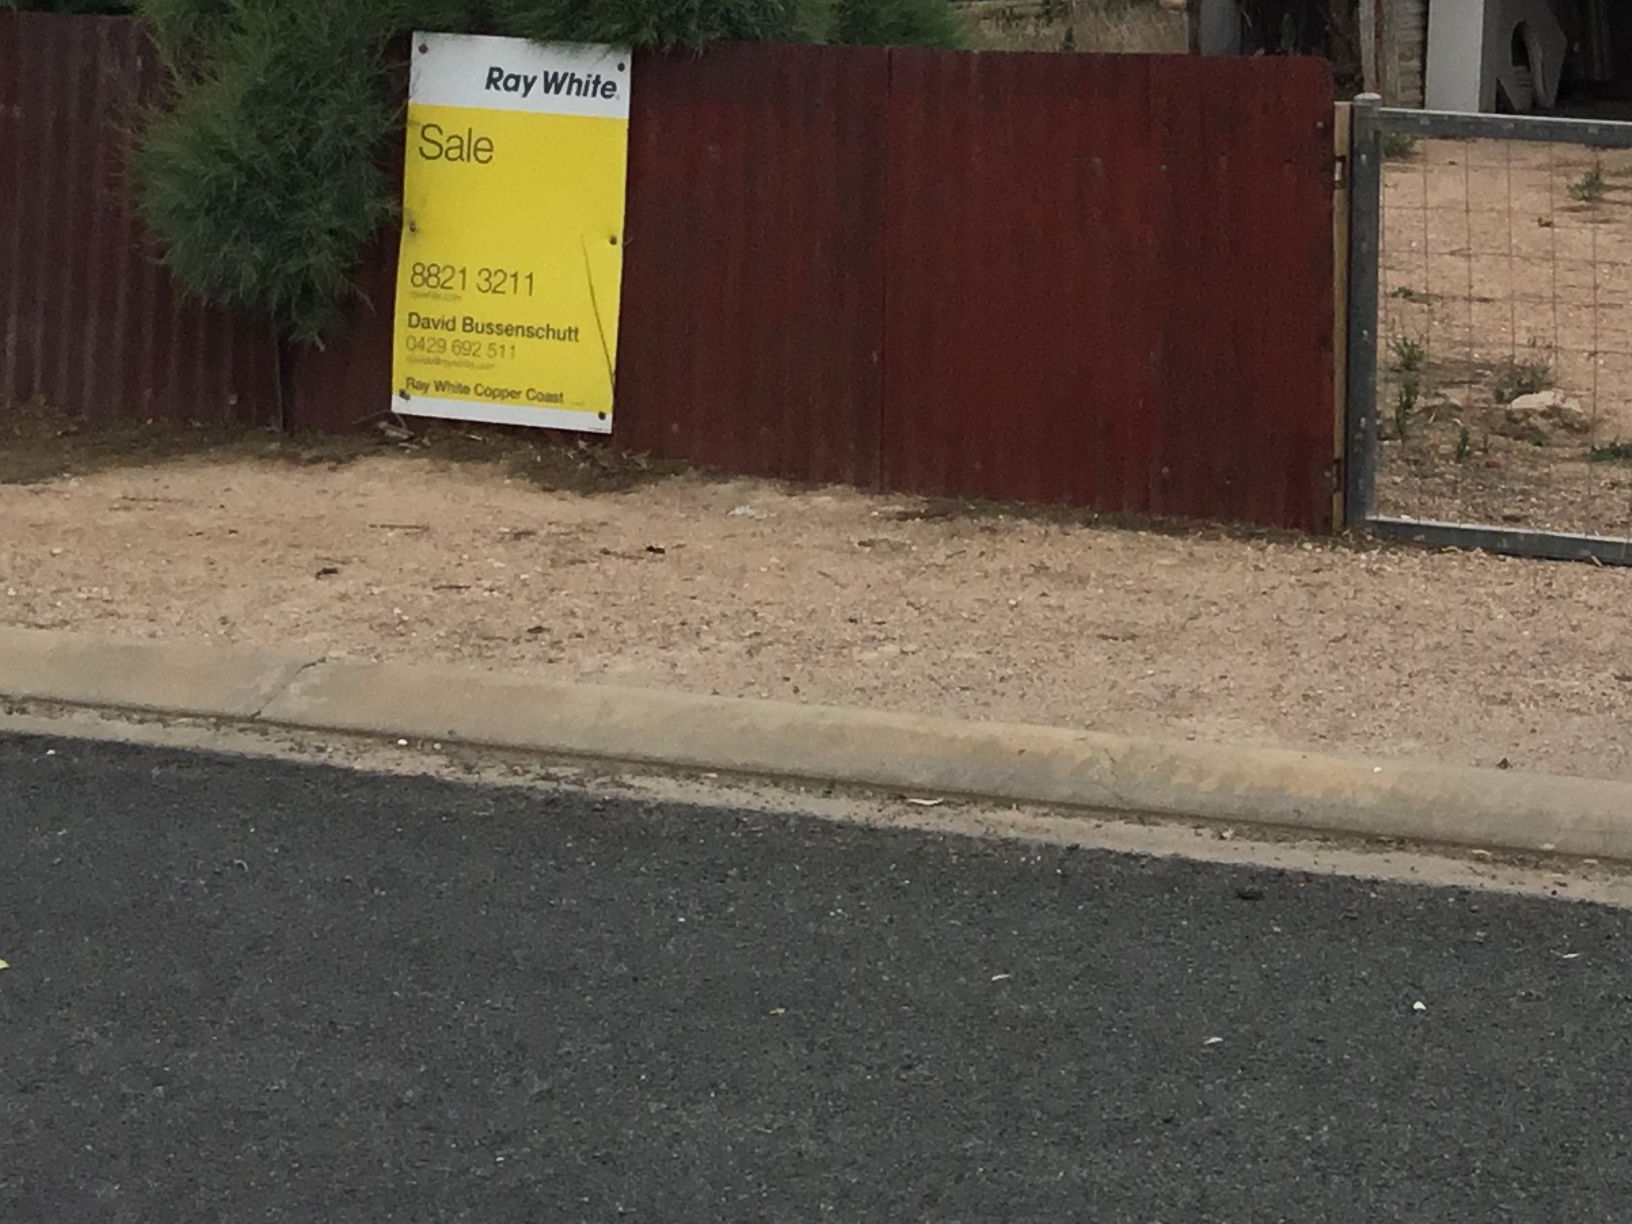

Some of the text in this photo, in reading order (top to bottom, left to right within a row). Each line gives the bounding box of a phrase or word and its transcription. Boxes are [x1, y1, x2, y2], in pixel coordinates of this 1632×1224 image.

[485, 66, 618, 99] Ray White
[418, 122, 495, 164] Sale
[410, 262, 534, 296] 8821 3211
[407, 312, 580, 343] David Bussenschutt
[406, 334, 516, 360] 0429 692 511
[405, 377, 564, 404] Ray White Copper Coast
